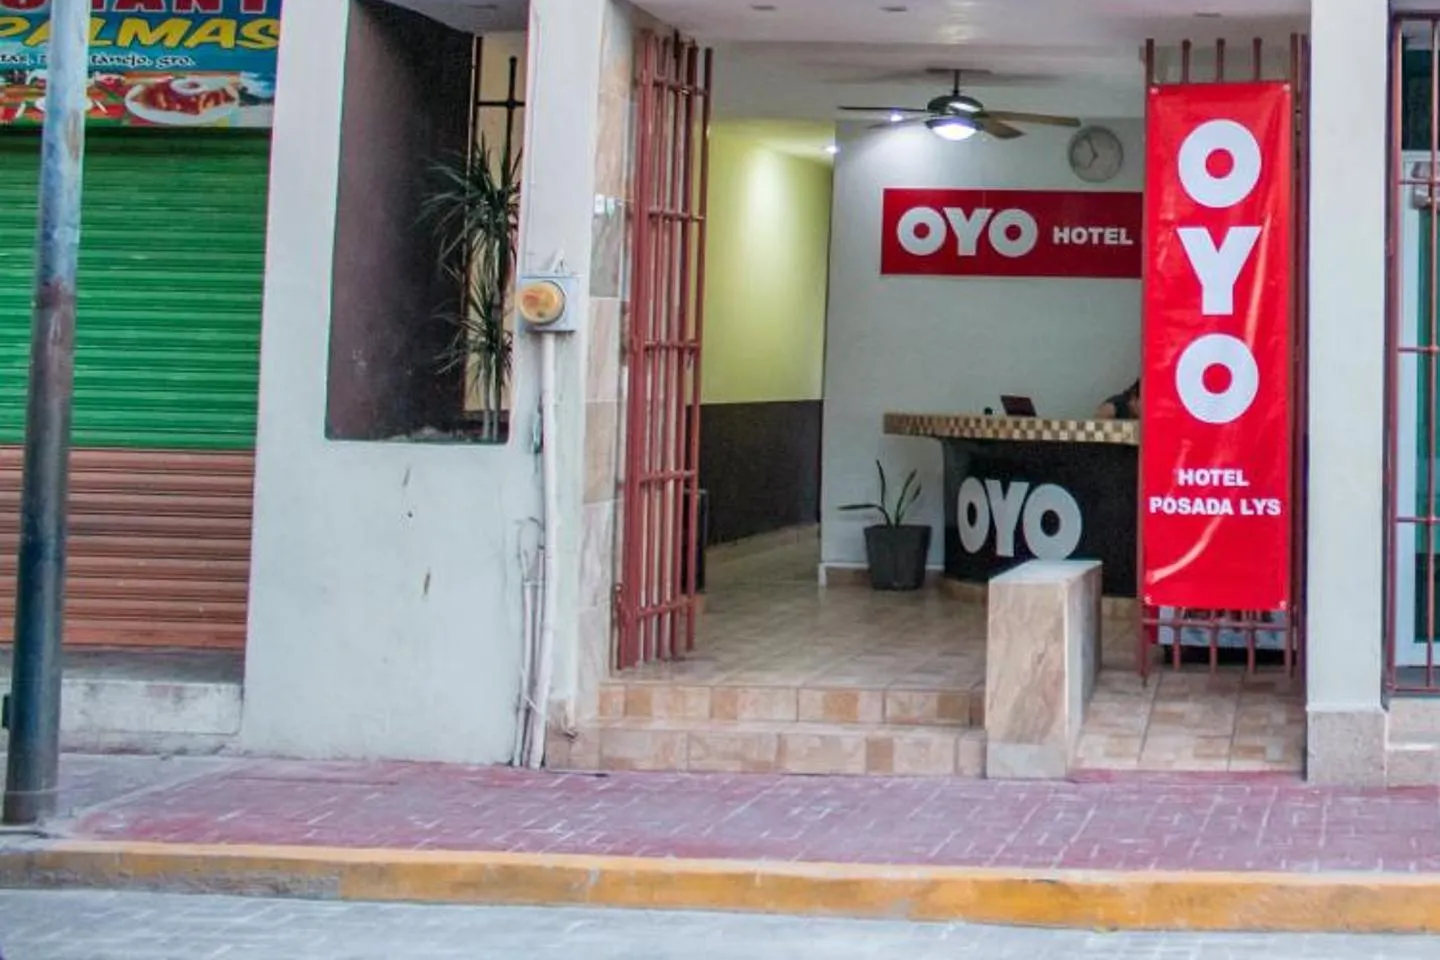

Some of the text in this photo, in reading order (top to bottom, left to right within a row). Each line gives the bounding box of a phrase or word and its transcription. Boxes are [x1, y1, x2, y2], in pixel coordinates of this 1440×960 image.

[897, 206, 1134, 257] OYO HOTEL
[1175, 118, 1262, 424] OYO
[1177, 468, 1250, 487] HOTEL
[957, 477, 1083, 560] OYO
[1148, 496, 1281, 515] POSADA LYS
